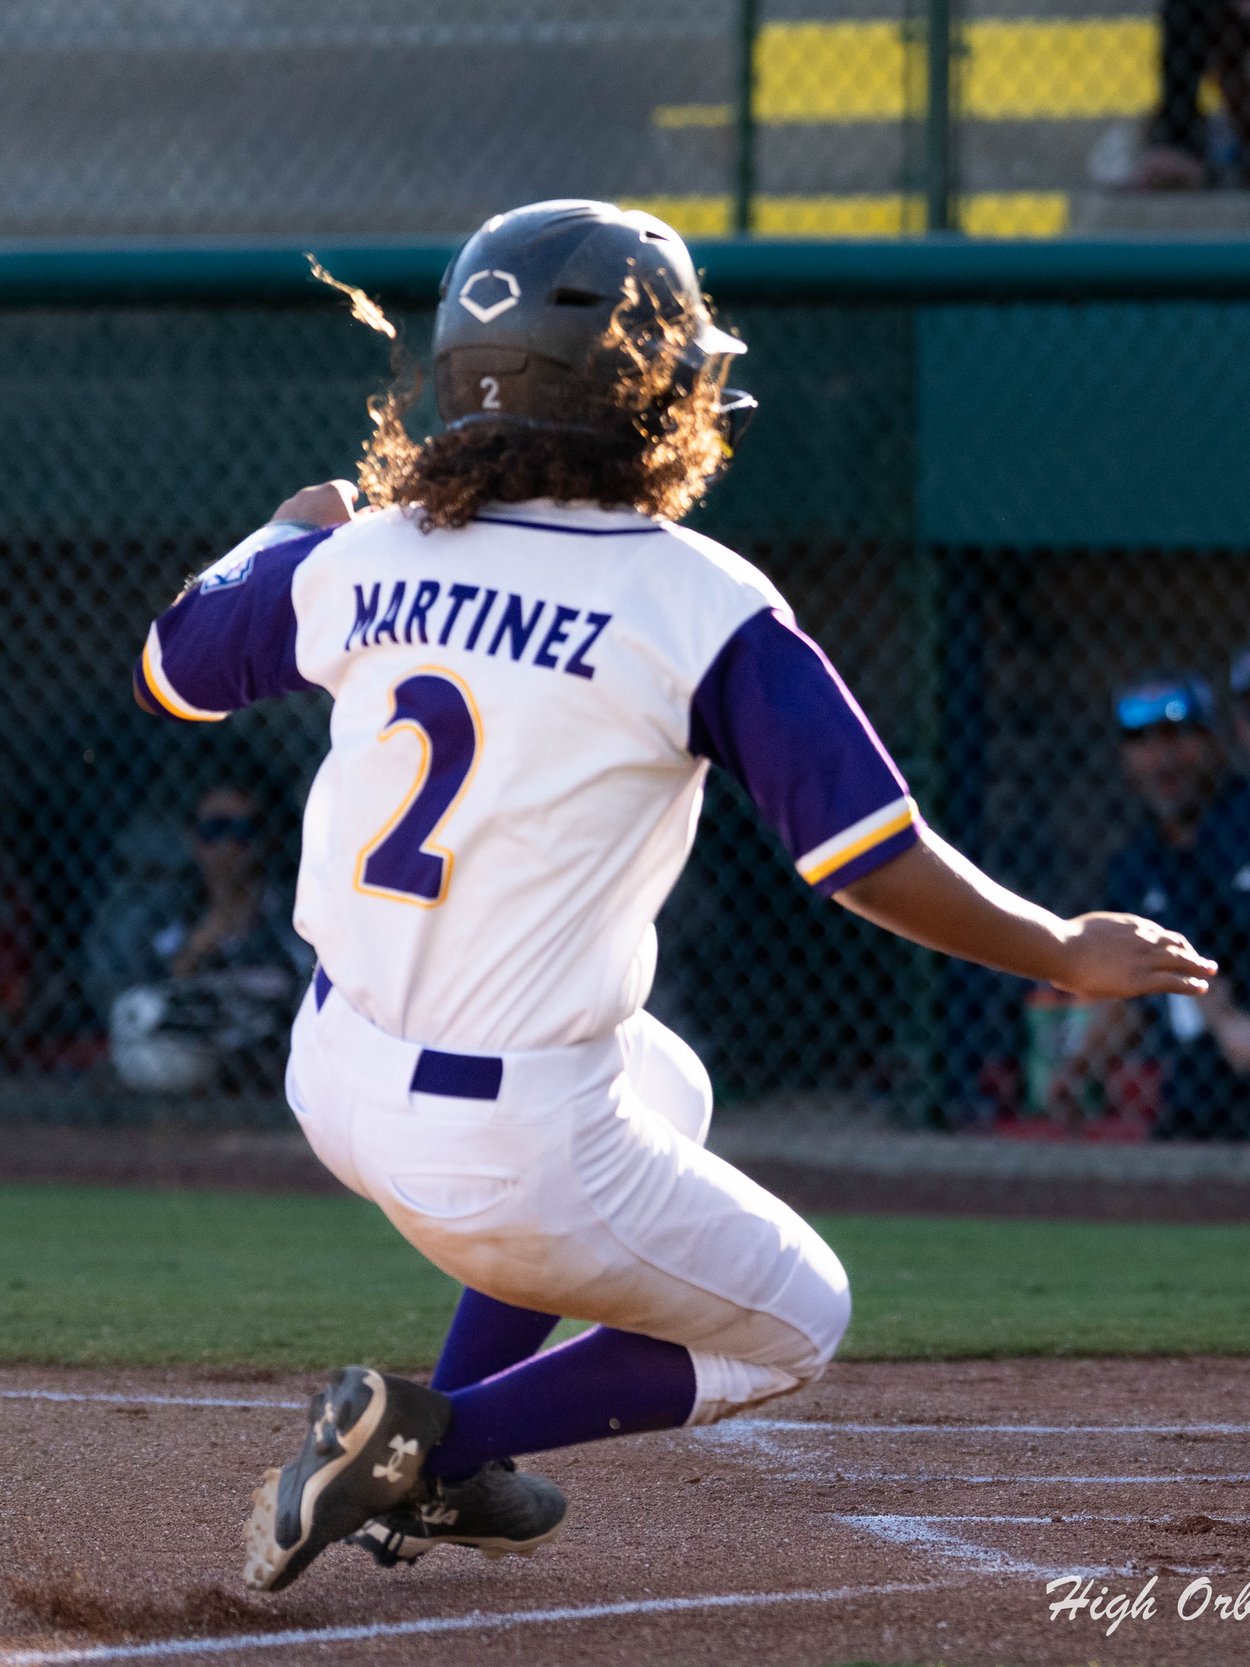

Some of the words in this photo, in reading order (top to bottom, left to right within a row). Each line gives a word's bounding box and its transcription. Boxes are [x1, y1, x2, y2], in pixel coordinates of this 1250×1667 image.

[480, 376, 501, 409] 2
[345, 580, 612, 681] MARTINEZ
[354, 664, 484, 908] 2
